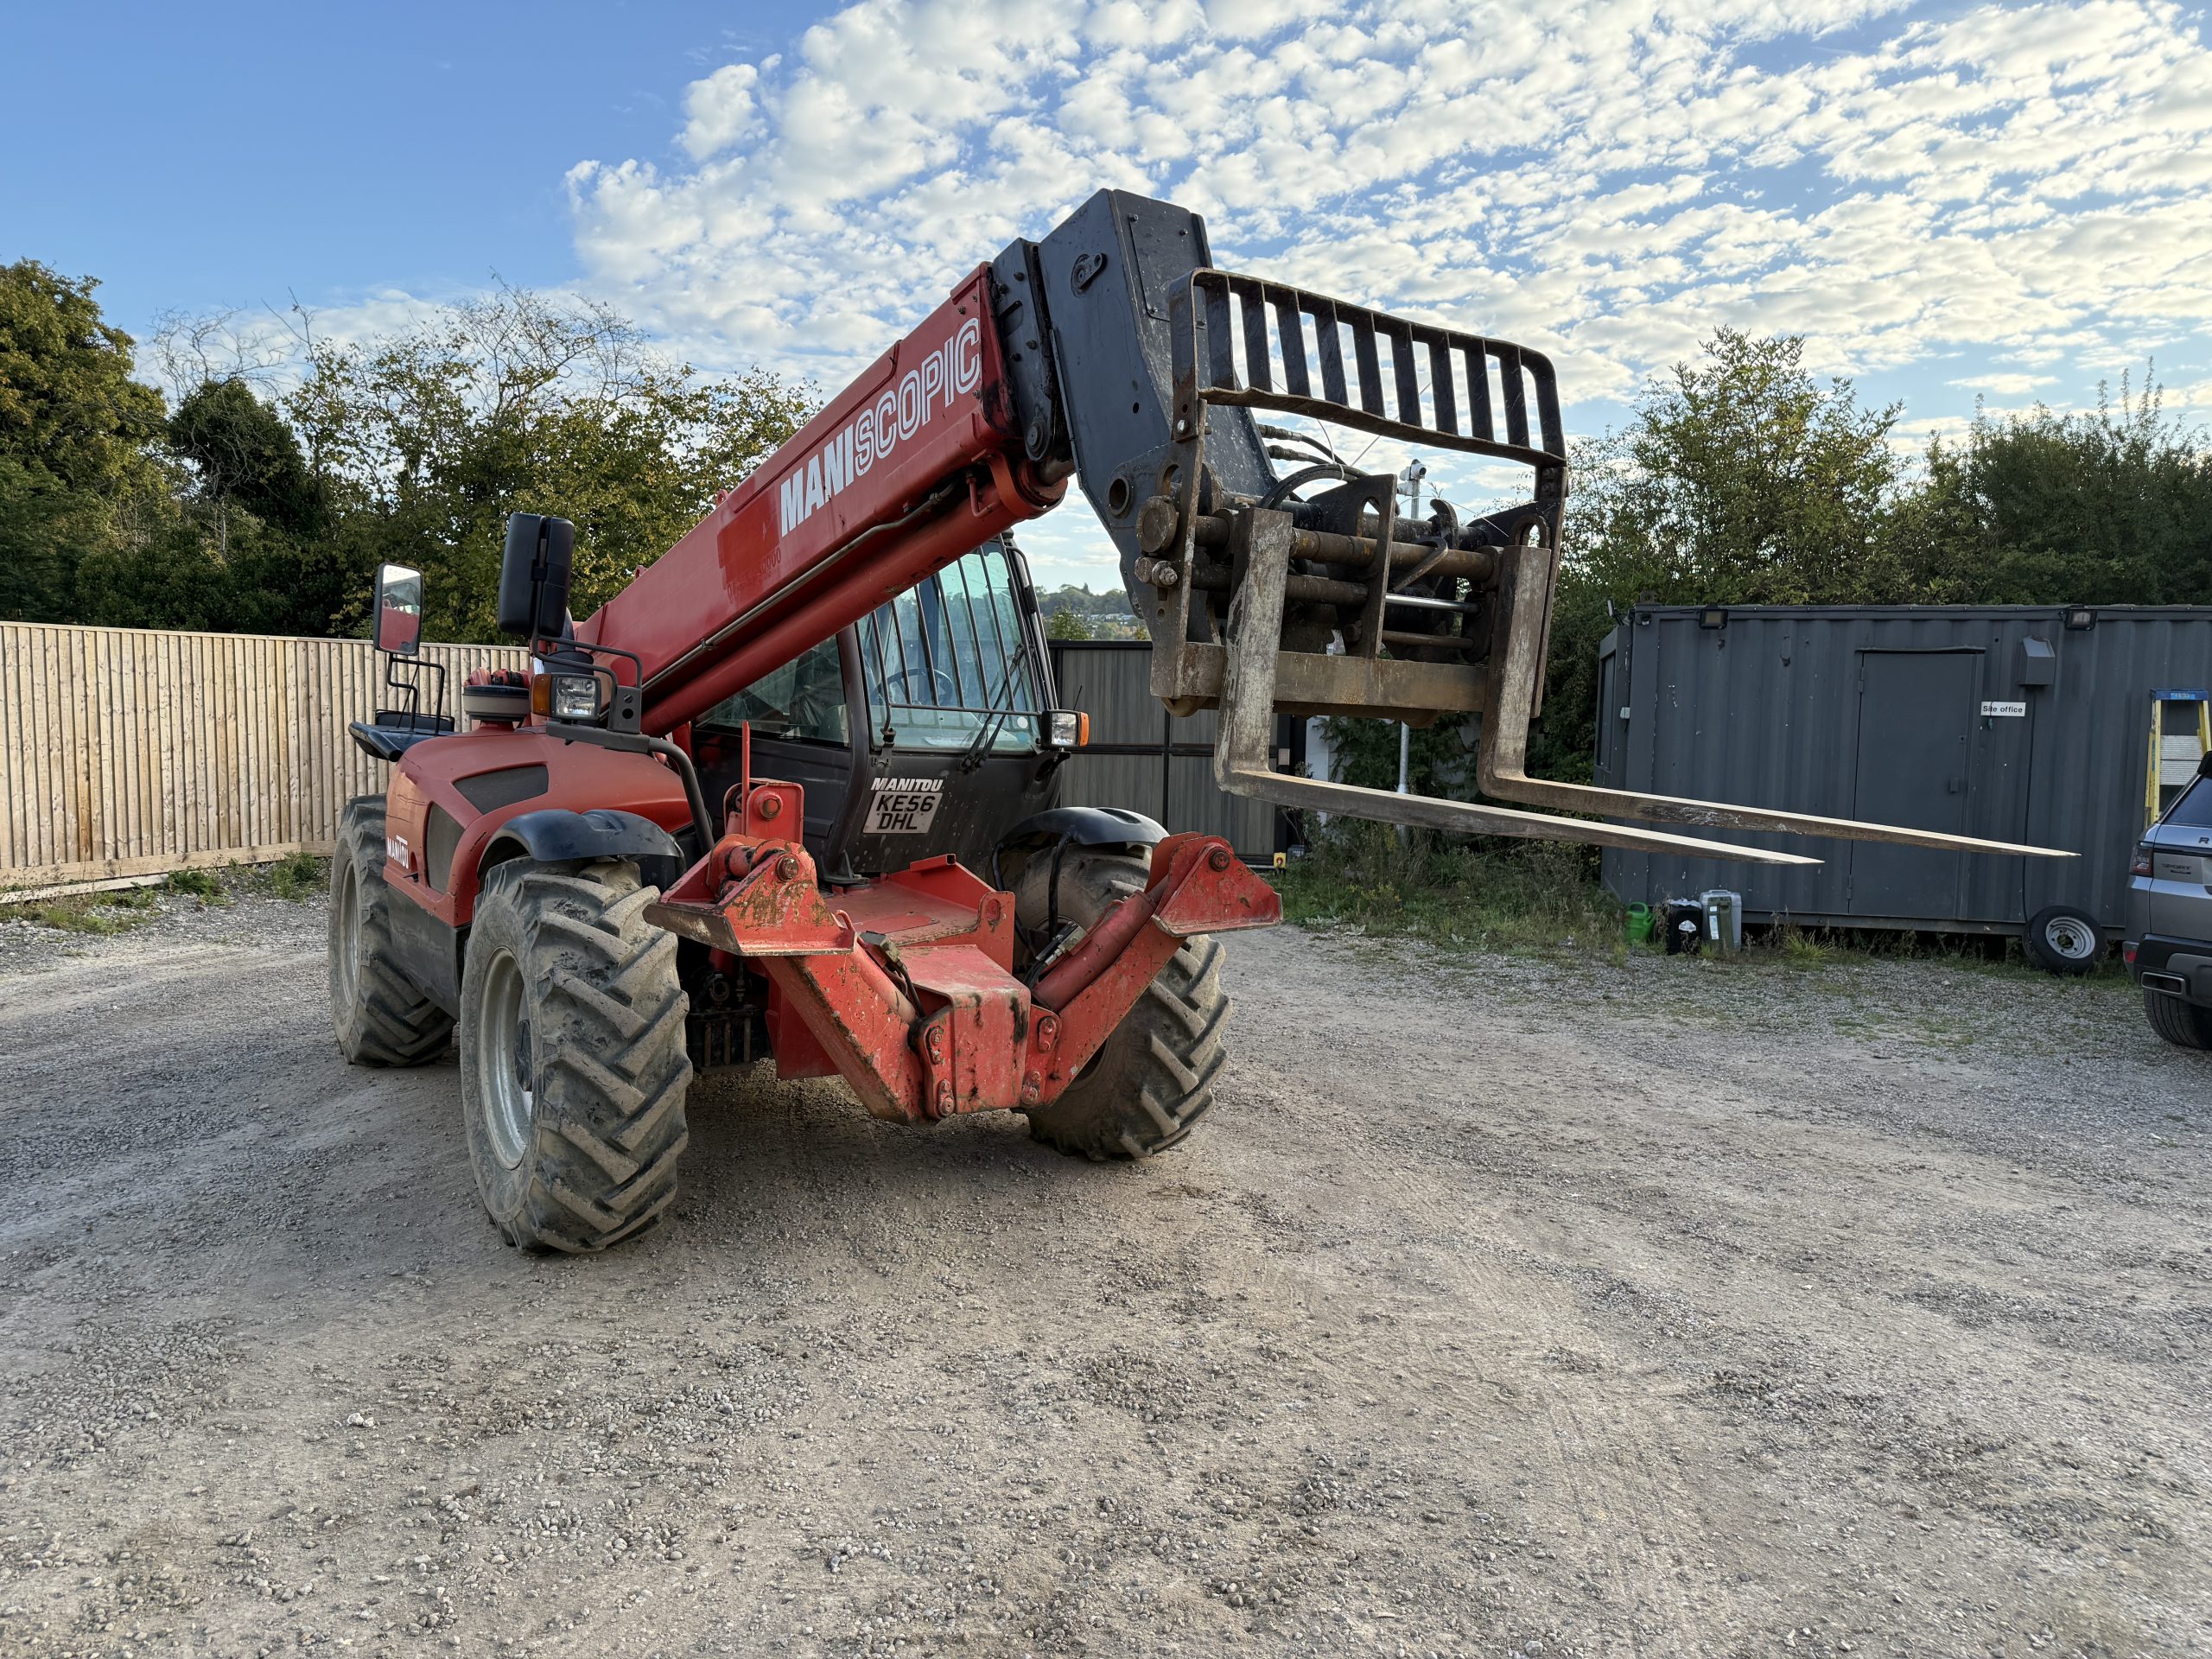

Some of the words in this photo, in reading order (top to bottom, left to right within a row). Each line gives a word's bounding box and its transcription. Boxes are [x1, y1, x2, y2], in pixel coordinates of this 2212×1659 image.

[781, 318, 979, 537] MANISCOPIC
[871, 778, 944, 791] MANITOU
[876, 795, 936, 811] KE56
[877, 813, 918, 830] DHL
[387, 835, 409, 869] MANITOU
